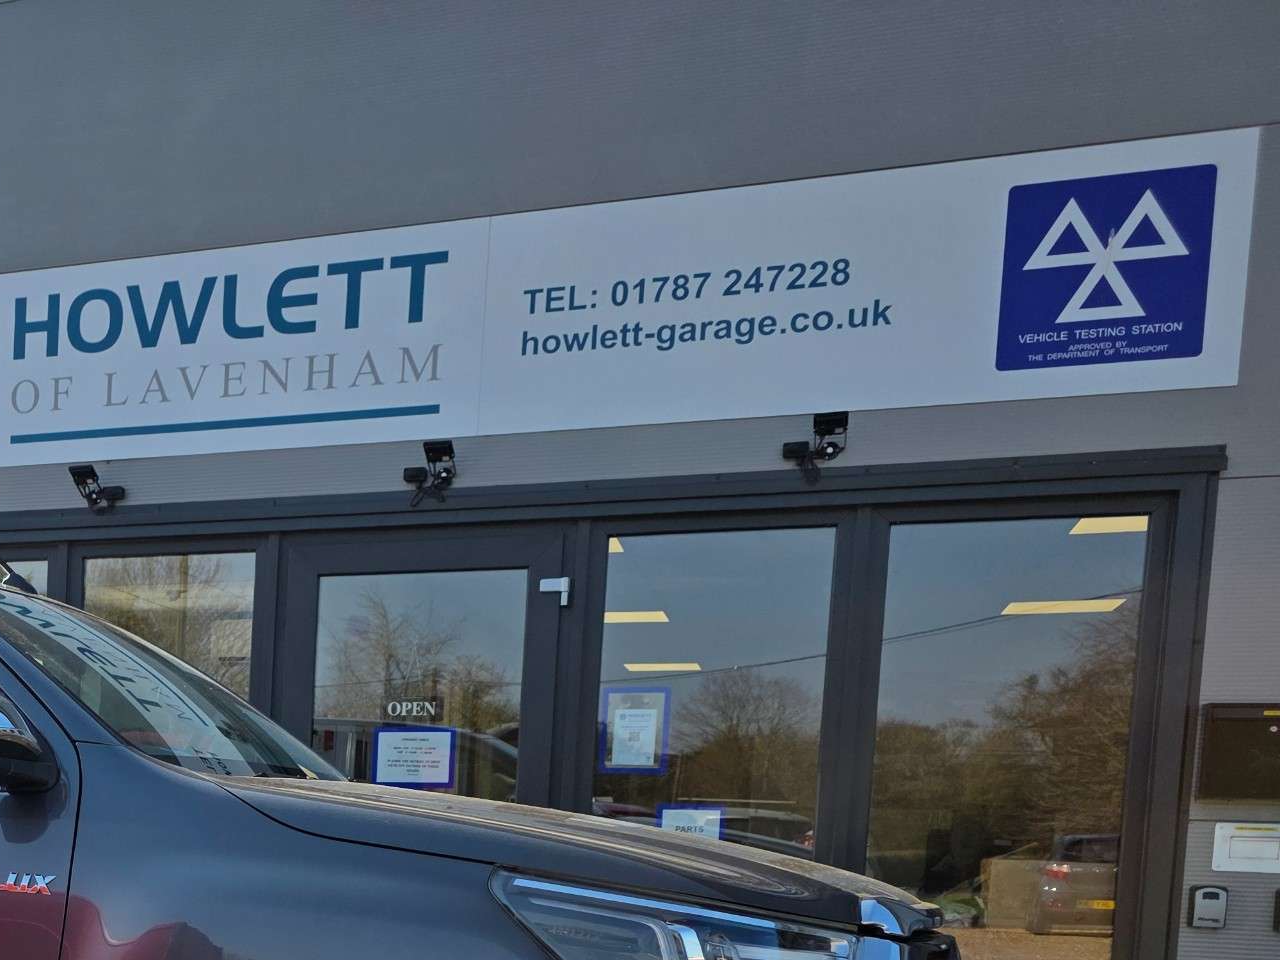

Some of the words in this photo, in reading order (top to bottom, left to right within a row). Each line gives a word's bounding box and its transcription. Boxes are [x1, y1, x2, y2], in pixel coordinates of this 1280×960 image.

[523, 286, 598, 315] TEL:
[611, 272, 711, 306] 01787
[722, 258, 851, 296] 247228
[12, 250, 449, 360] HOWLETT
[521, 299, 892, 356] howlett-garage.co.uk
[1019, 331, 1068, 344] VEHICLE
[1075, 326, 1126, 340] TESTING
[1132, 322, 1183, 335] STATION
[1047, 351, 1100, 361] DEPARTMENT
[1120, 344, 1169, 355] TRANSPORT
[1069, 342, 1112, 351] APPROVED
[11, 375, 73, 415] OF
[104, 343, 444, 407] LAVENHAM
[387, 701, 437, 717] OPEN
[675, 825, 705, 833] PARTS
